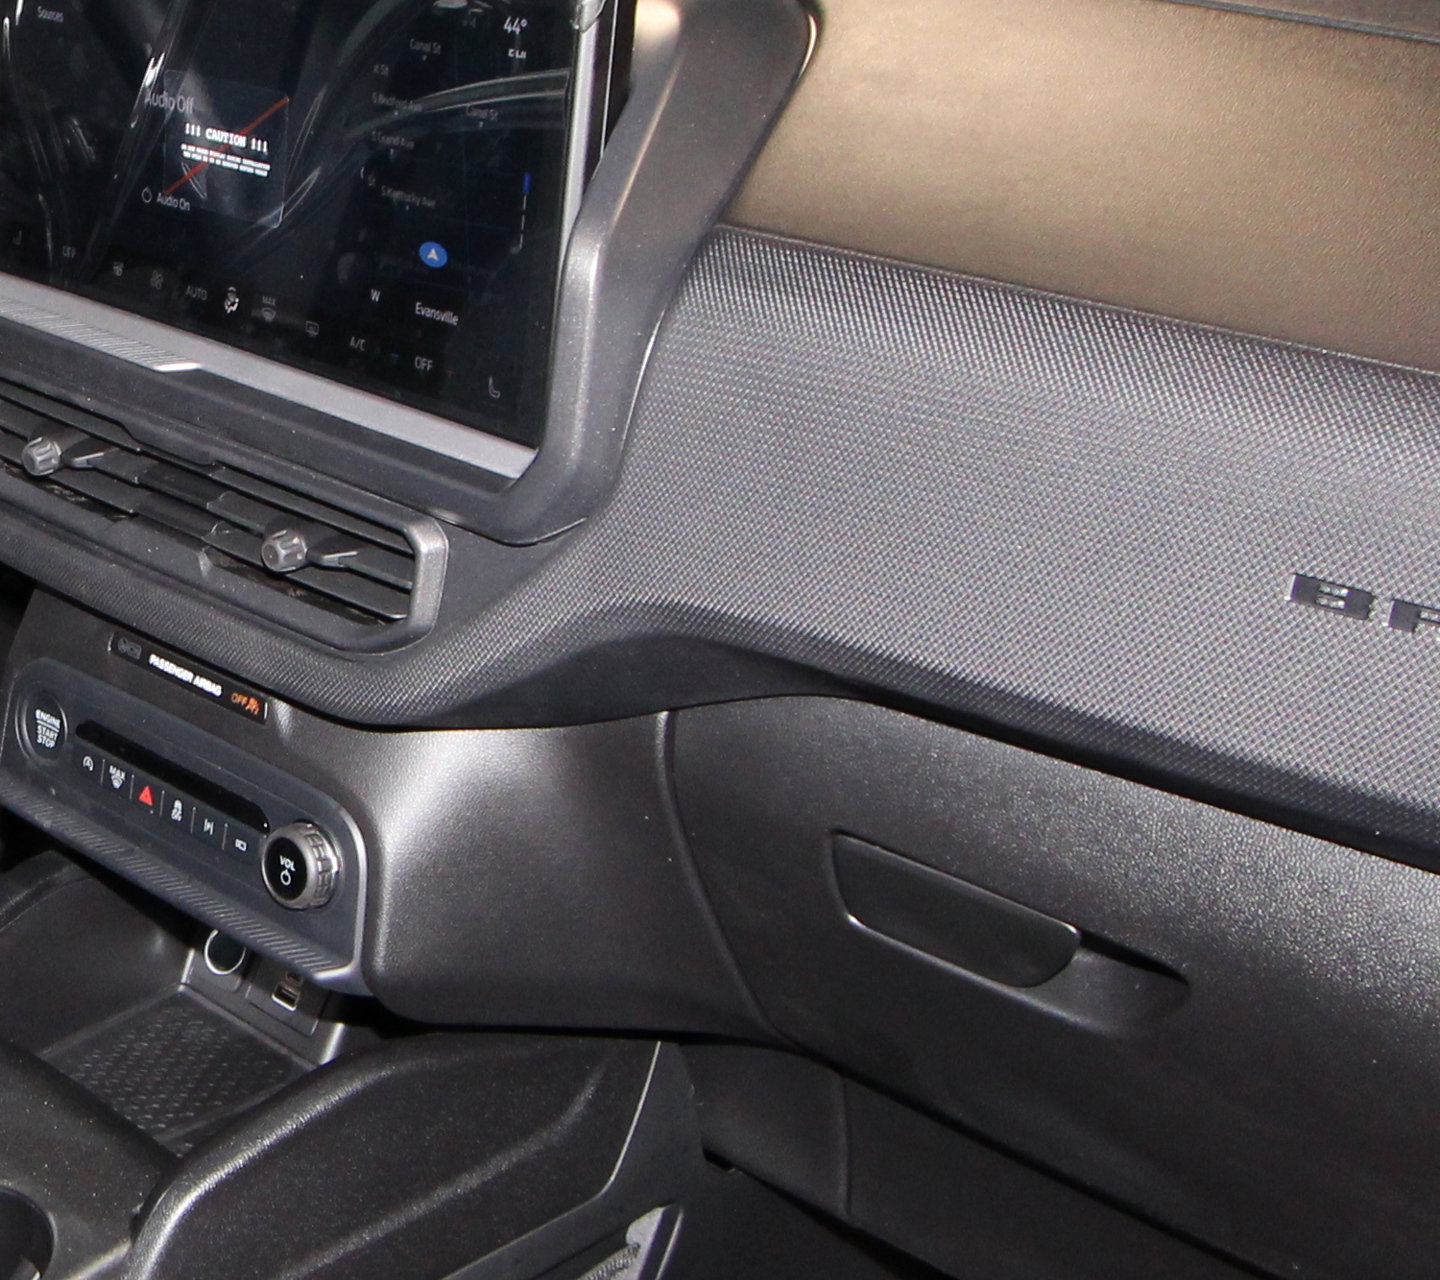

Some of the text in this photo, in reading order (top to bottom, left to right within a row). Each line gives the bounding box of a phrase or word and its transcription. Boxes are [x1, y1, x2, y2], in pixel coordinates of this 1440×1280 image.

[37, 5, 64, 23] Sources
[144, 89, 195, 115] Audio Off
[205, 127, 247, 148] CAUTION
[156, 193, 191, 211] Audio On
[185, 285, 208, 302] AUTO
[262, 295, 277, 307] MAX
[371, 289, 381, 303] W
[415, 302, 459, 326] Evansville
[349, 336, 366, 352] A/C
[415, 356, 433, 372] OFF
[149, 653, 223, 697] PASSENGER AIRBAG
[231, 692, 248, 707] OFF
[35, 709, 61, 727] ENGINE
[36, 724, 58, 742] START
[37, 734, 56, 750] STOP
[109, 764, 126, 780] MAX
[279, 855, 296, 872] VOL
